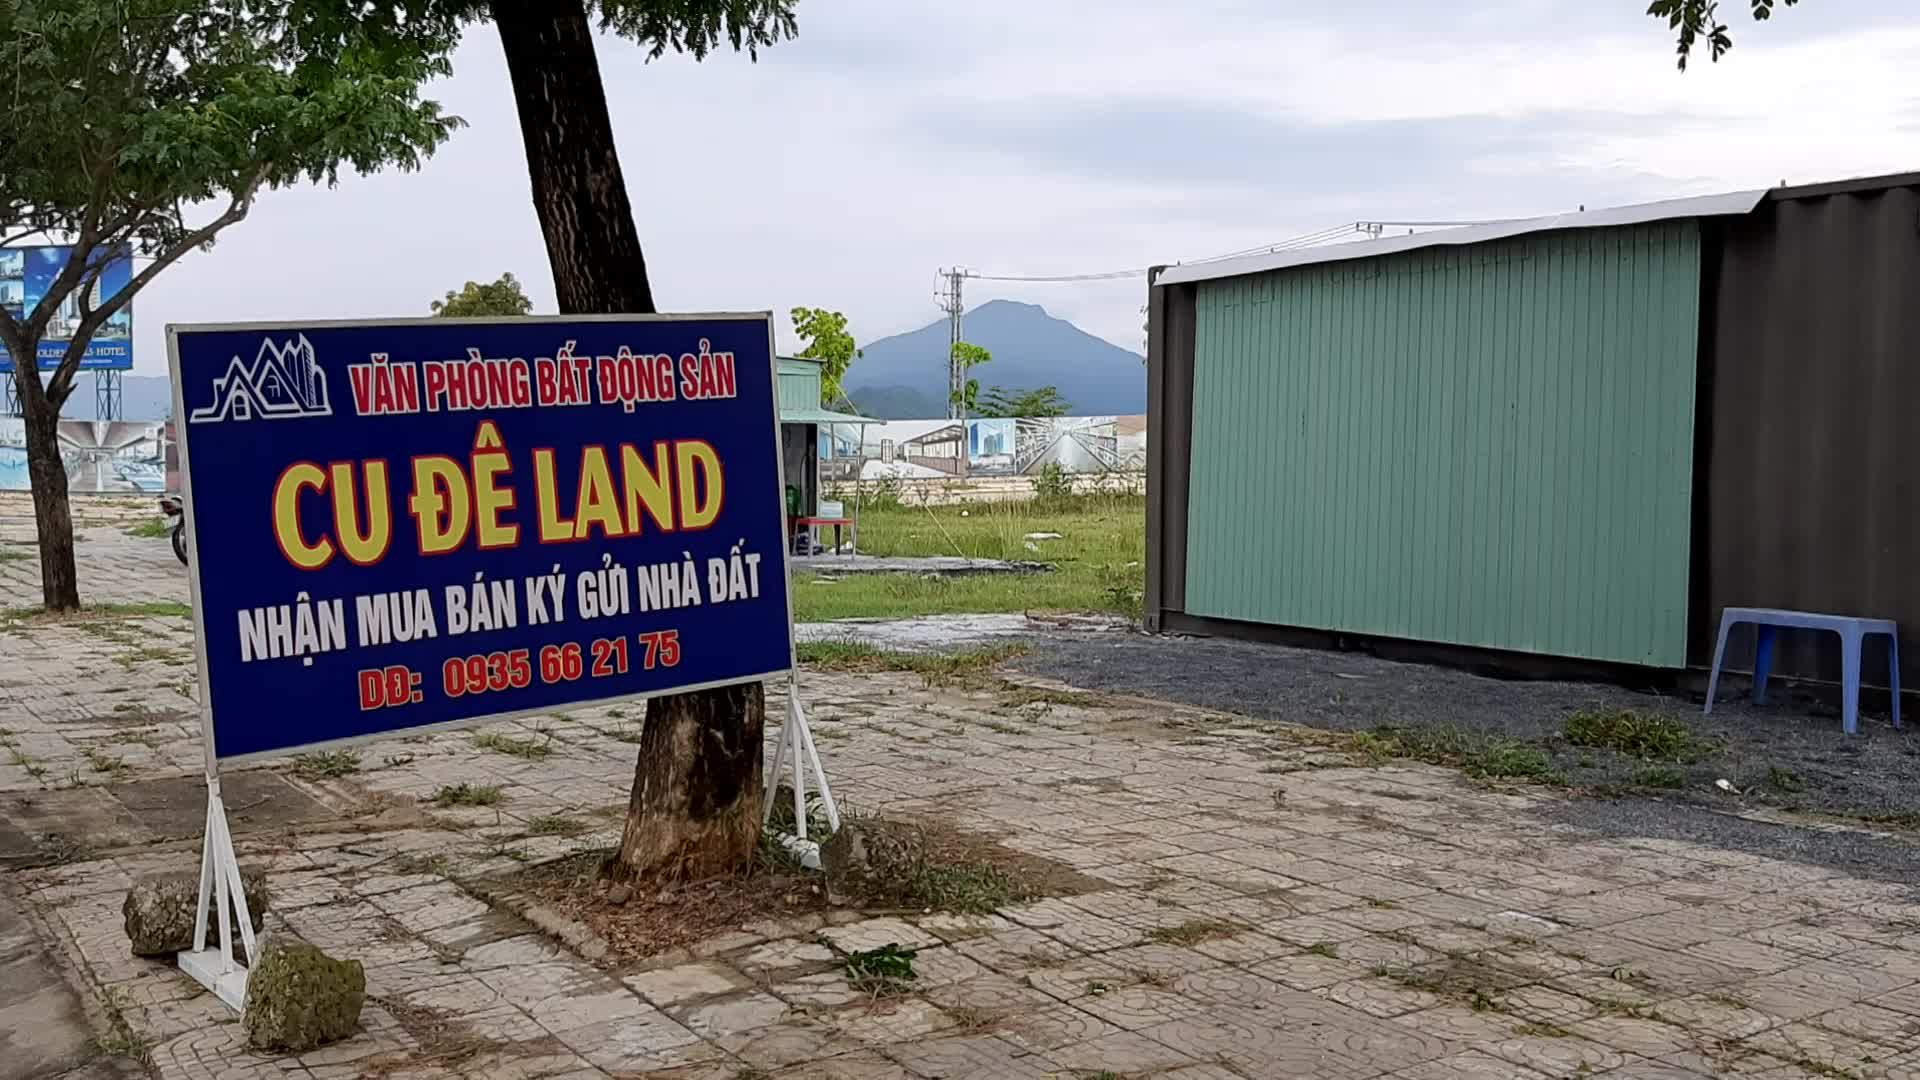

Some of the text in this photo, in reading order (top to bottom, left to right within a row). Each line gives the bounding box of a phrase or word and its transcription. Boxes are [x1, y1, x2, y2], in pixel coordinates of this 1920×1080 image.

[96, 347, 126, 356] HOTEL
[348, 338, 737, 416] VĂN PHÒNG BẤT ĐỘNG SẢN
[272, 419, 726, 570] CU ĐÊ LAND
[237, 538, 762, 667] NHẬN MUA BÁN KÝ GỬI NHÀ ĐẤT
[358, 629, 681, 711] DĐ: 0935 66 21 75
